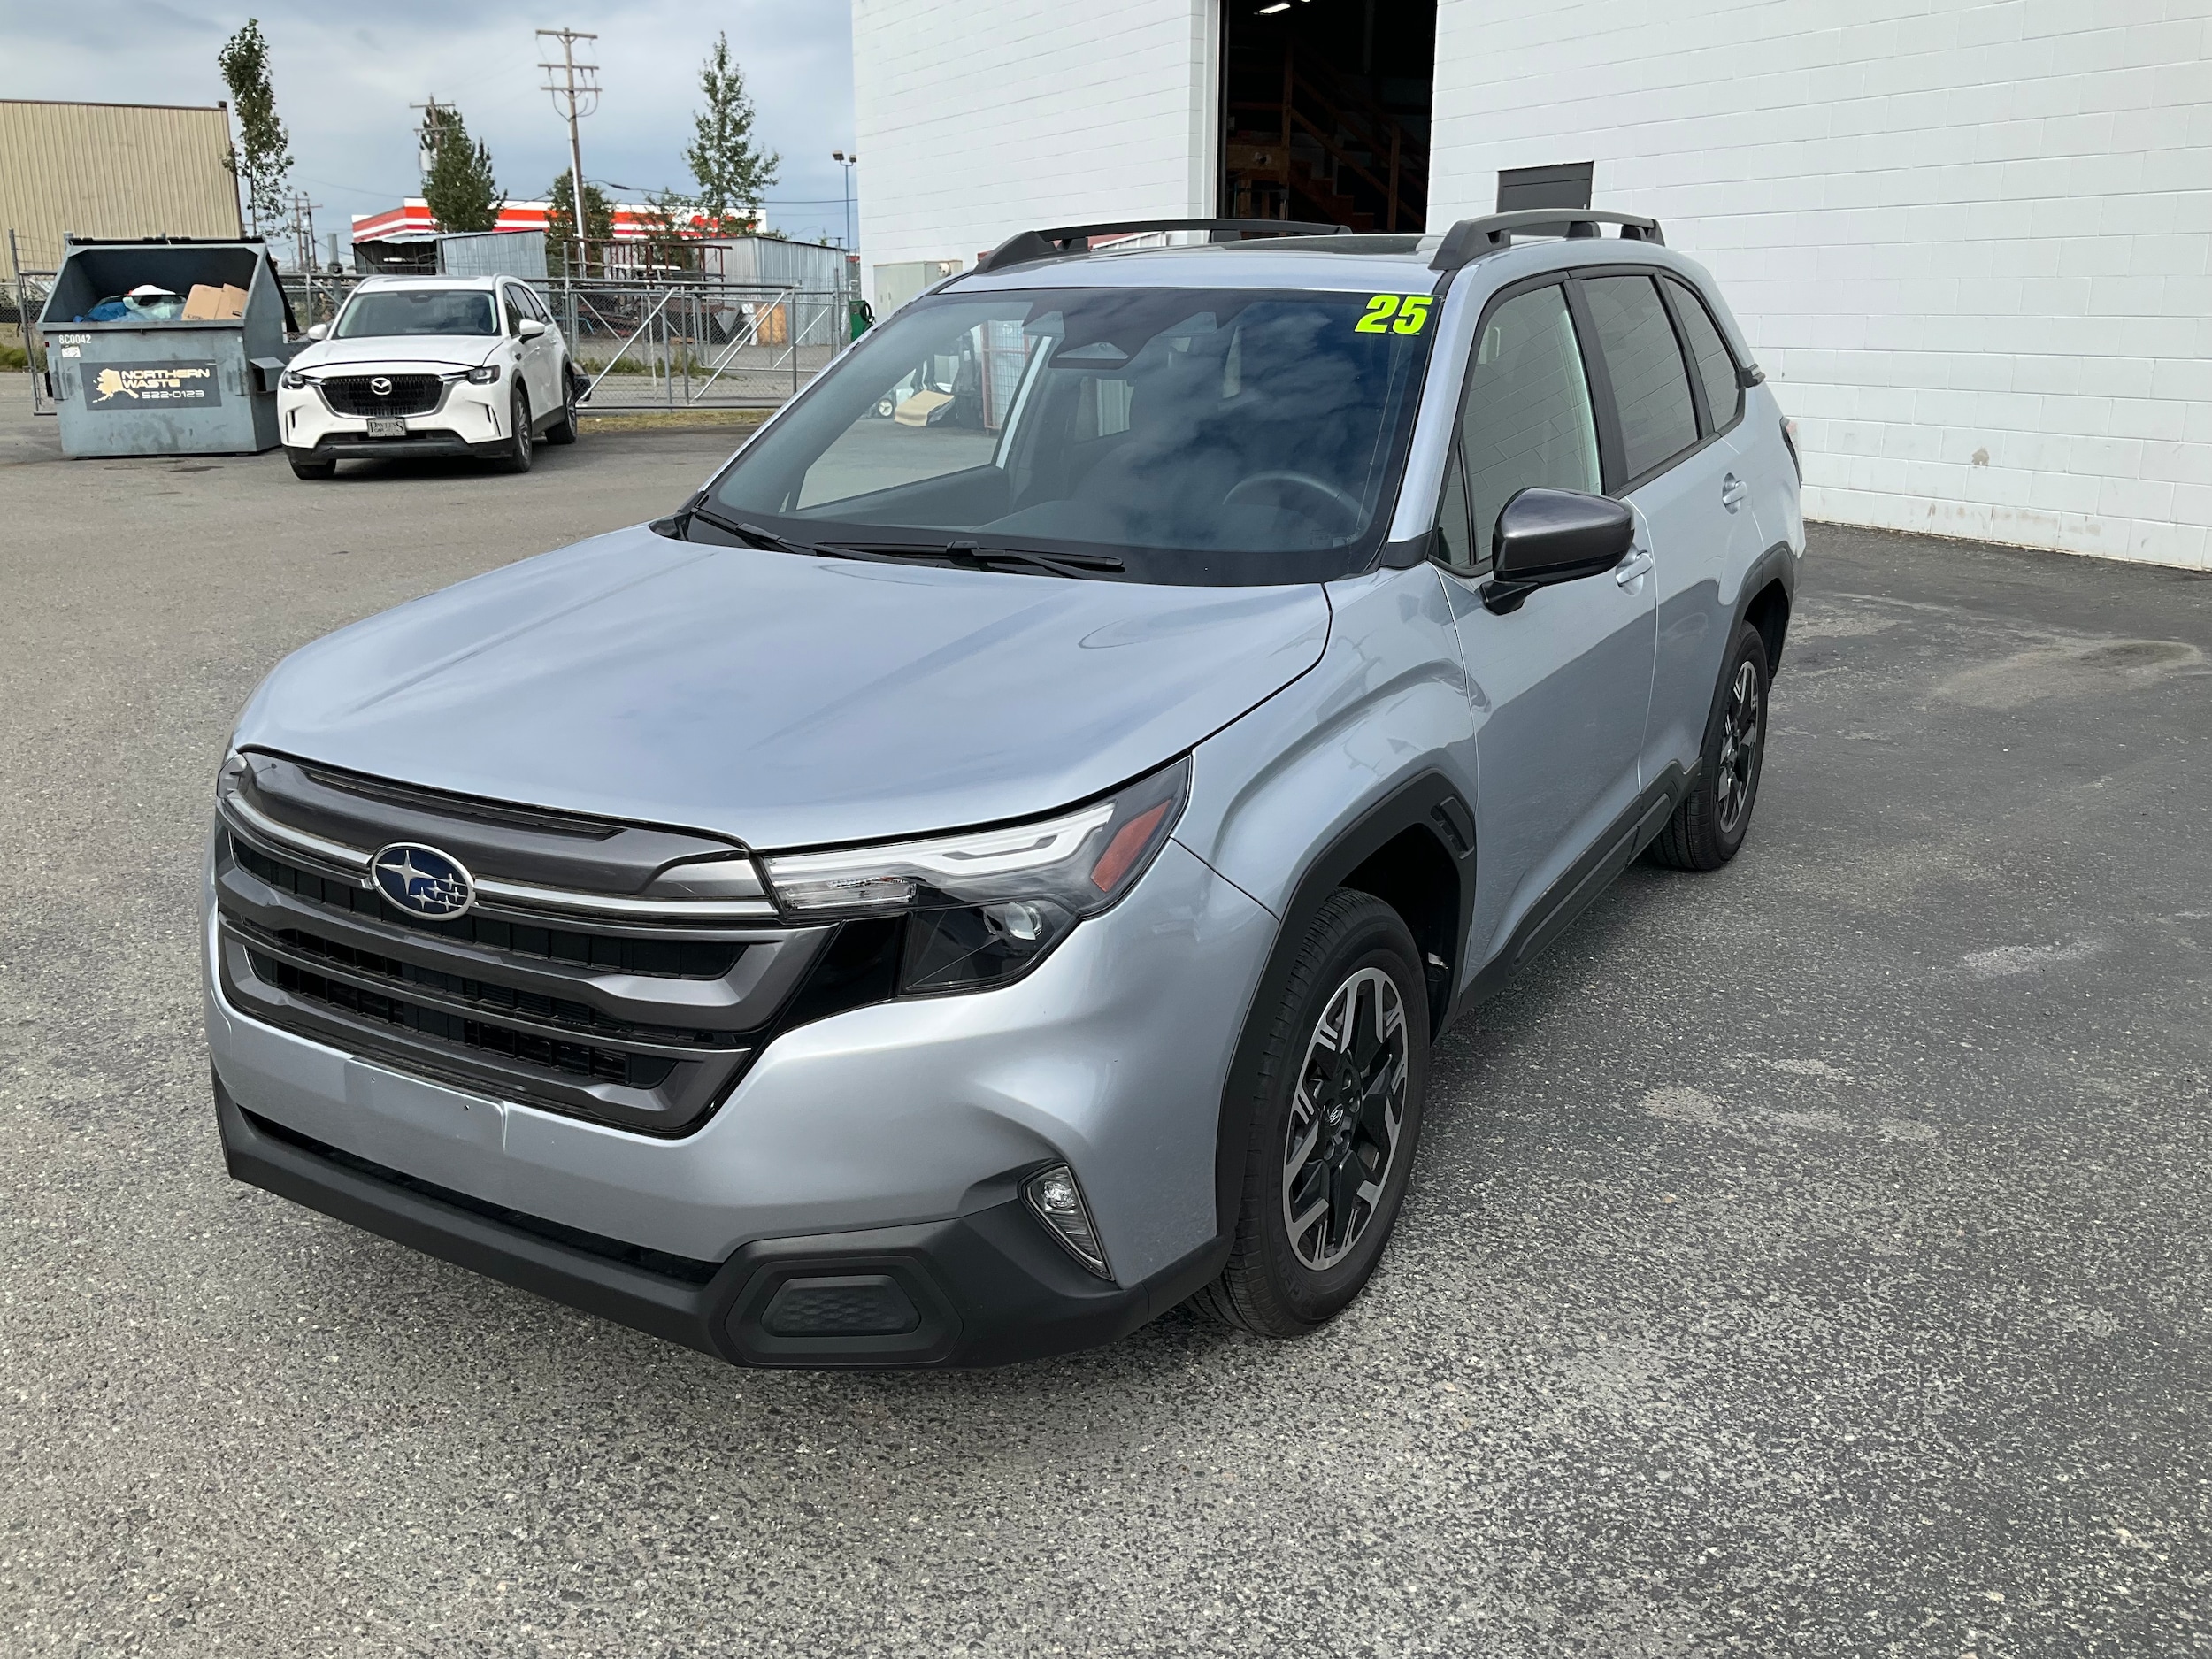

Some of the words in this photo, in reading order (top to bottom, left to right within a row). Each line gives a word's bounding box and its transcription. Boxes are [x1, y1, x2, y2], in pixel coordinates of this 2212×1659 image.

[1355, 295, 1433, 334] 25
[121, 368, 210, 379] NORTHERN
[122, 379, 180, 388] WASTE
[142, 390, 204, 399] 522-0123
